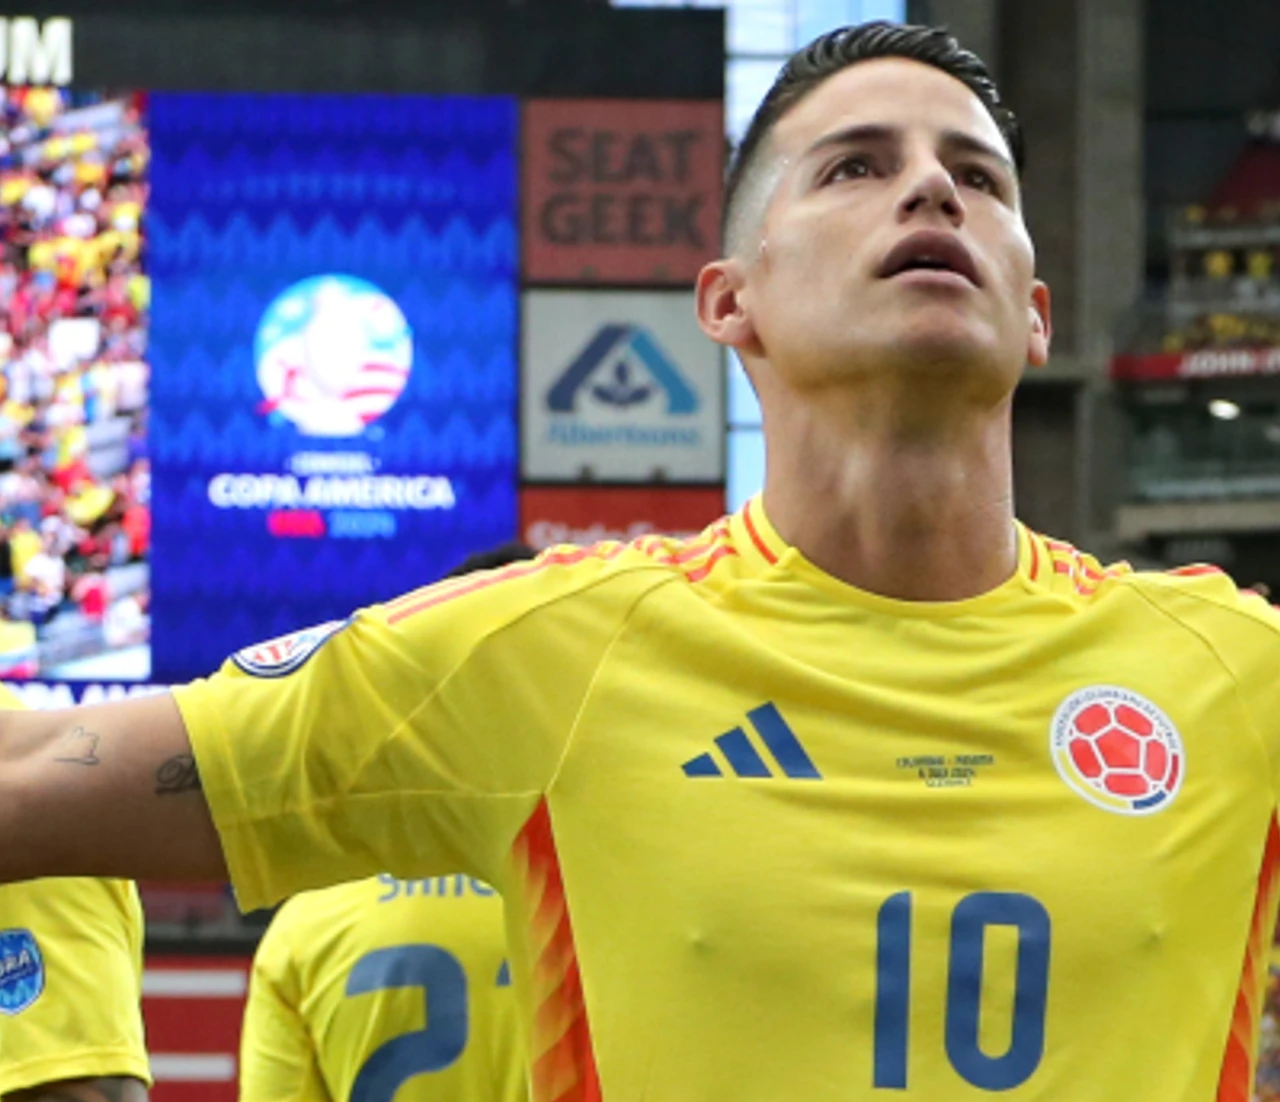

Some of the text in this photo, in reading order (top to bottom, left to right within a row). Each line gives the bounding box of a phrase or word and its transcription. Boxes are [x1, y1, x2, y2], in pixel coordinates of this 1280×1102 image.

[549, 128, 700, 184] SEAT
[541, 191, 707, 249] GEEK
[208, 473, 301, 509] COPA
[873, 889, 1051, 1092] 10
